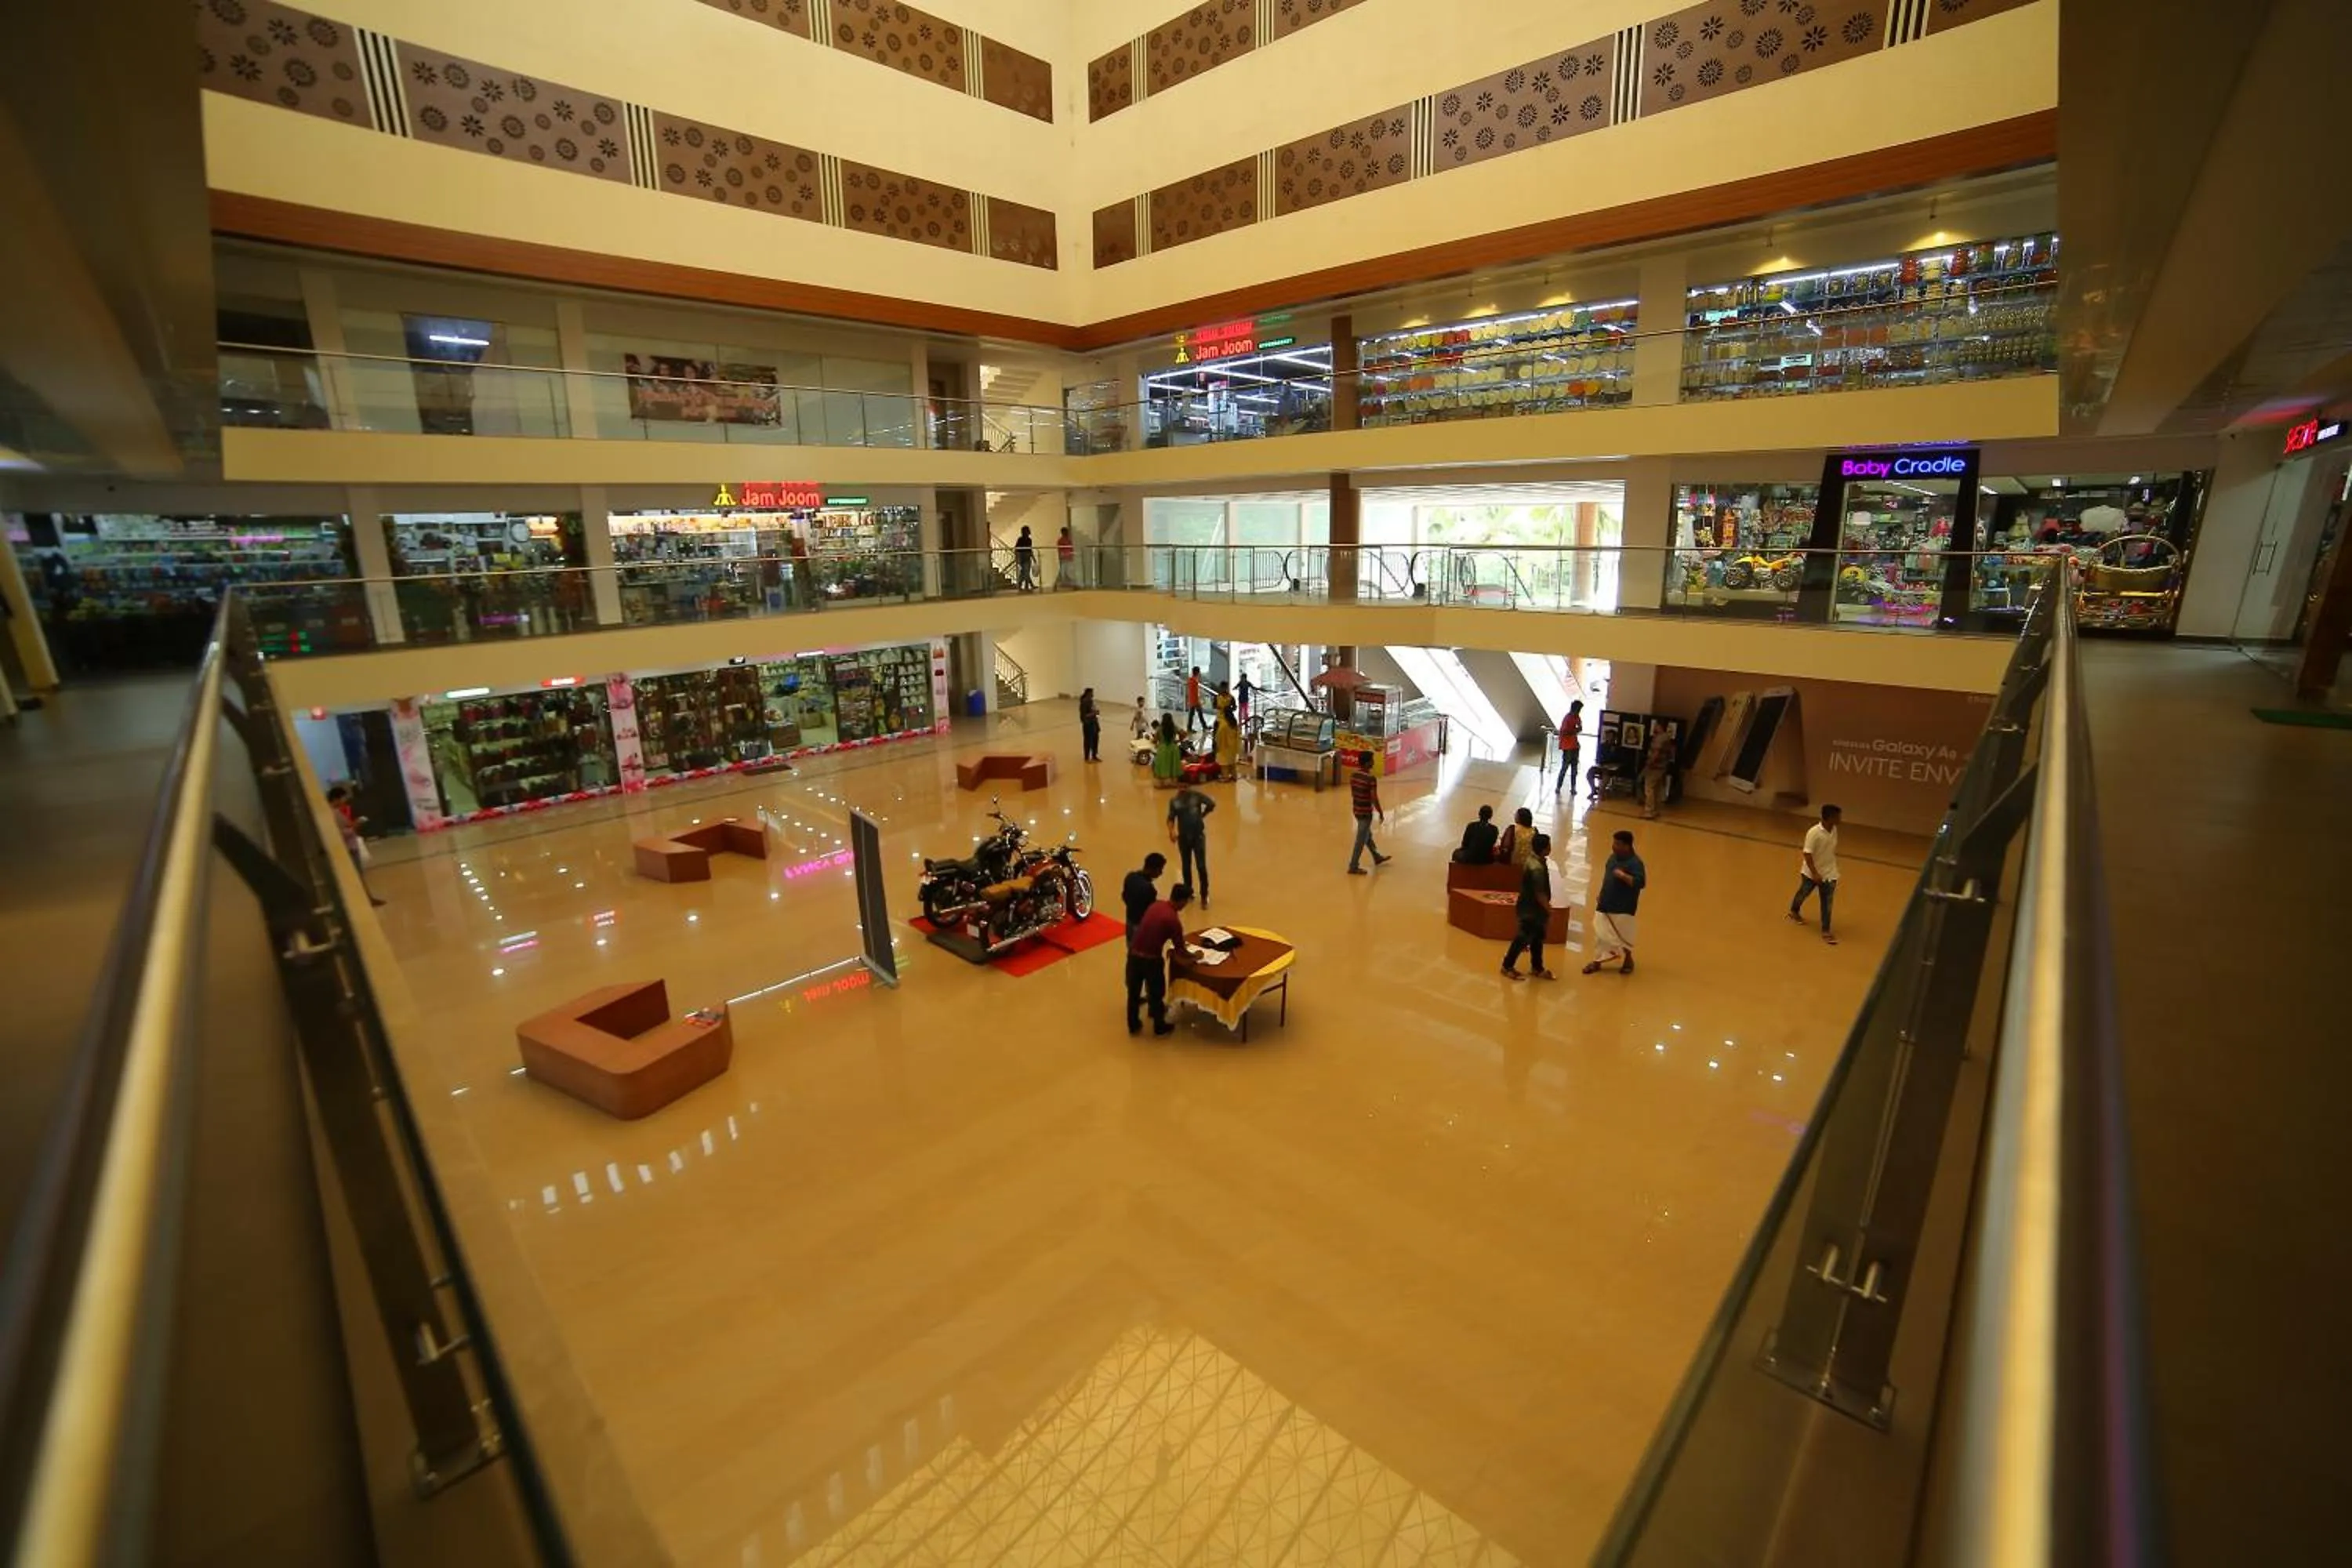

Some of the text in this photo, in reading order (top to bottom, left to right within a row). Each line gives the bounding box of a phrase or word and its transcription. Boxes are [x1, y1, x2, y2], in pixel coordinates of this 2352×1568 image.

[1196, 339, 1253, 360] Jam Joom
[1842, 456, 1965, 477] Baby Cradle
[742, 489, 775, 506] Jam
[779, 489, 820, 506] Joom
[1872, 739, 1935, 759] Galaxy
[1829, 752, 1904, 779] INVITE
